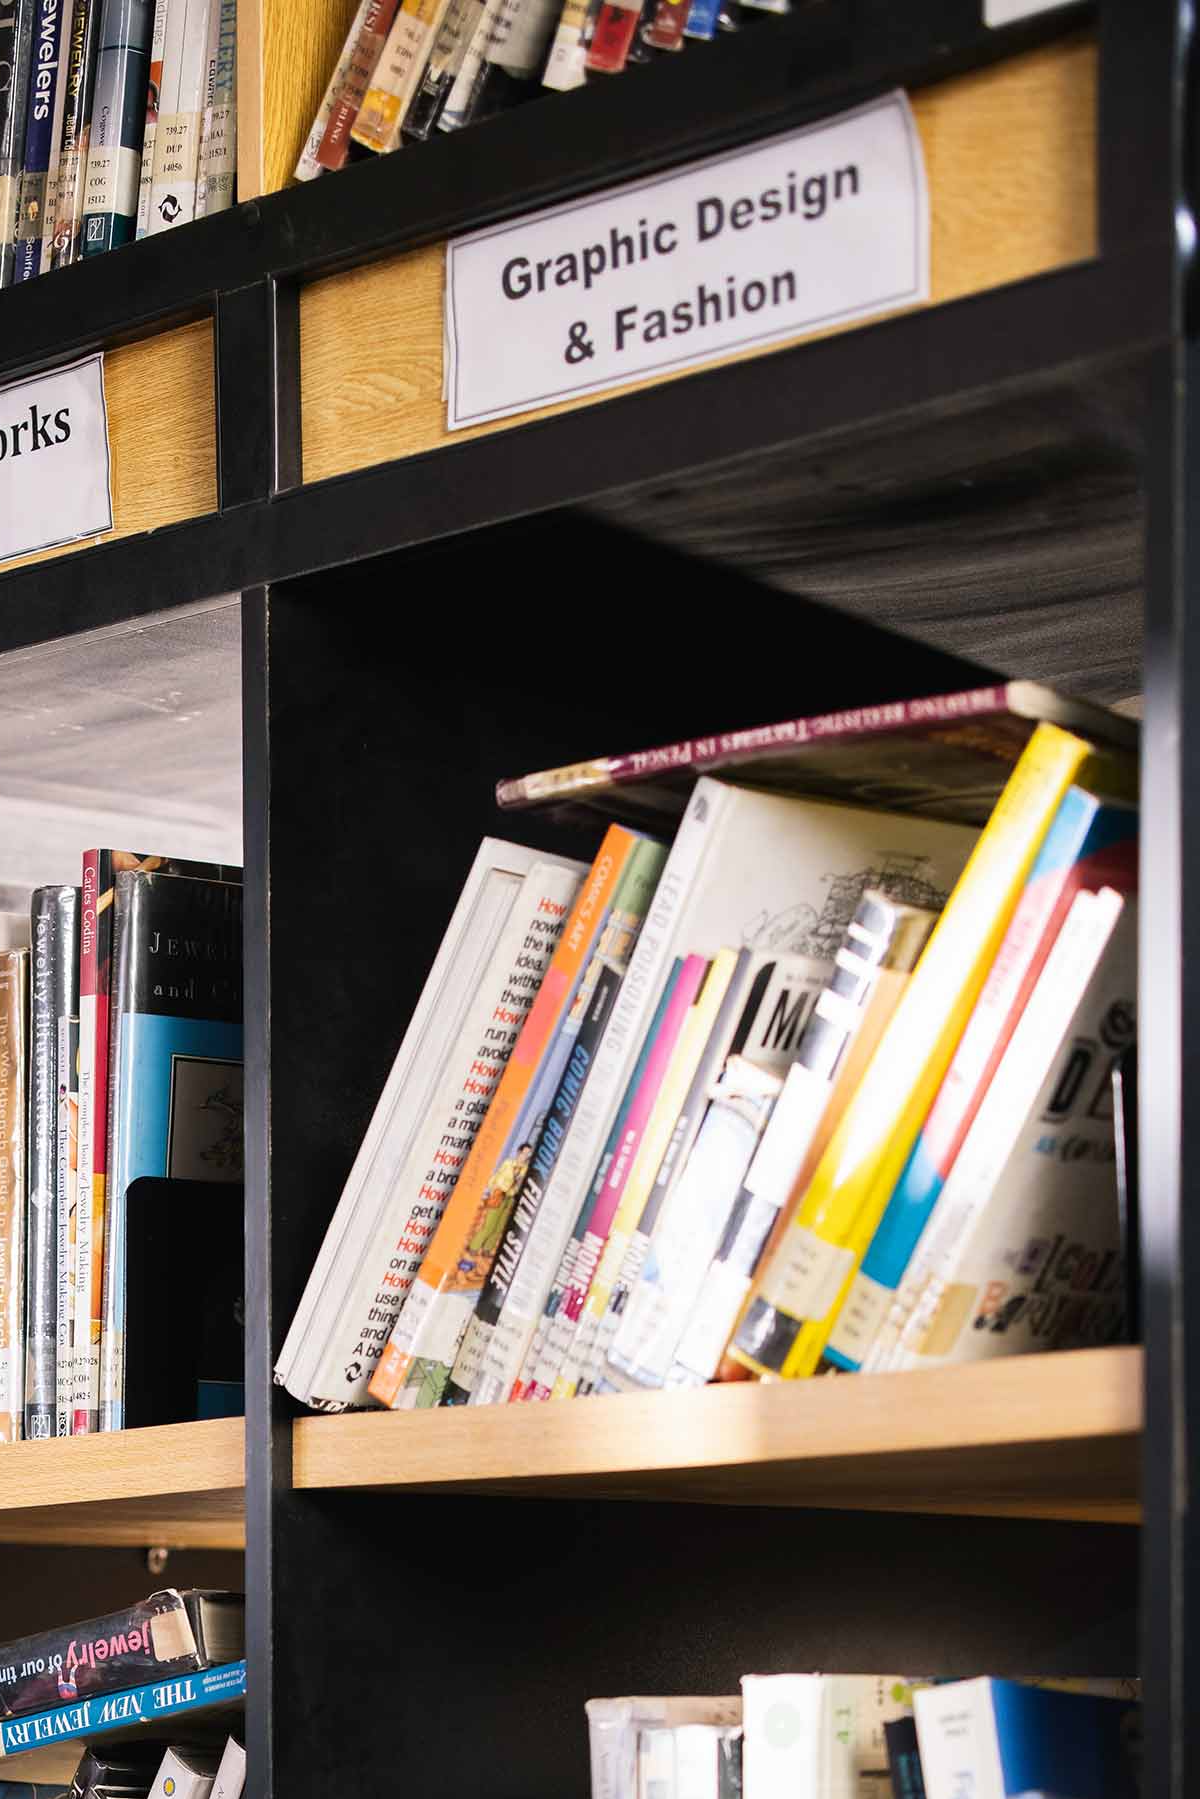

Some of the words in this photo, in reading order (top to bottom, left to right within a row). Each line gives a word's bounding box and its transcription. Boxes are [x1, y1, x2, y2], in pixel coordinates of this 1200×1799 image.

[502, 214, 680, 302] Graphic
[696, 162, 862, 246] Design
[565, 320, 597, 366] &
[614, 268, 799, 354] Fashion
[82, 866, 96, 905] Carles
[580, 855, 614, 920] COMICS
[537, 897, 567, 918] How
[81, 909, 96, 955] Codina
[567, 923, 585, 953] ART
[523, 935, 543, 951] the
[34, 912, 51, 1003] Jewelry
[514, 952, 544, 972] idea.
[492, 1007, 521, 1025] How
[484, 1027, 507, 1043] run
[477, 1044, 512, 1062] avoid
[469, 1060, 499, 1078] How
[555, 1043, 591, 1115] COMIC
[463, 1077, 492, 1096] How
[455, 1097, 465, 1110] a
[432, 1149, 463, 1168] How
[532, 1118, 564, 1179] BOOK
[425, 1168, 435, 1182] a
[417, 1184, 449, 1202] How
[410, 1204, 434, 1221] get
[511, 1178, 543, 1233] FILM
[403, 1218, 435, 1238] How
[396, 1235, 427, 1255] How
[388, 1257, 407, 1271] on
[489, 1231, 525, 1292] STYLE
[381, 1270, 412, 1289] How
[374, 1291, 400, 1306] use
[359, 1324, 387, 1342] and
[352, 1342, 364, 1355] A
[66, 1619, 151, 1670] jewelry
[21, 1659, 46, 1676] our
[49, 1653, 63, 1674] of
[153, 1678, 197, 1707] THE
[97, 1691, 145, 1724] NEW
[5, 1708, 91, 1749] JEWELRY
